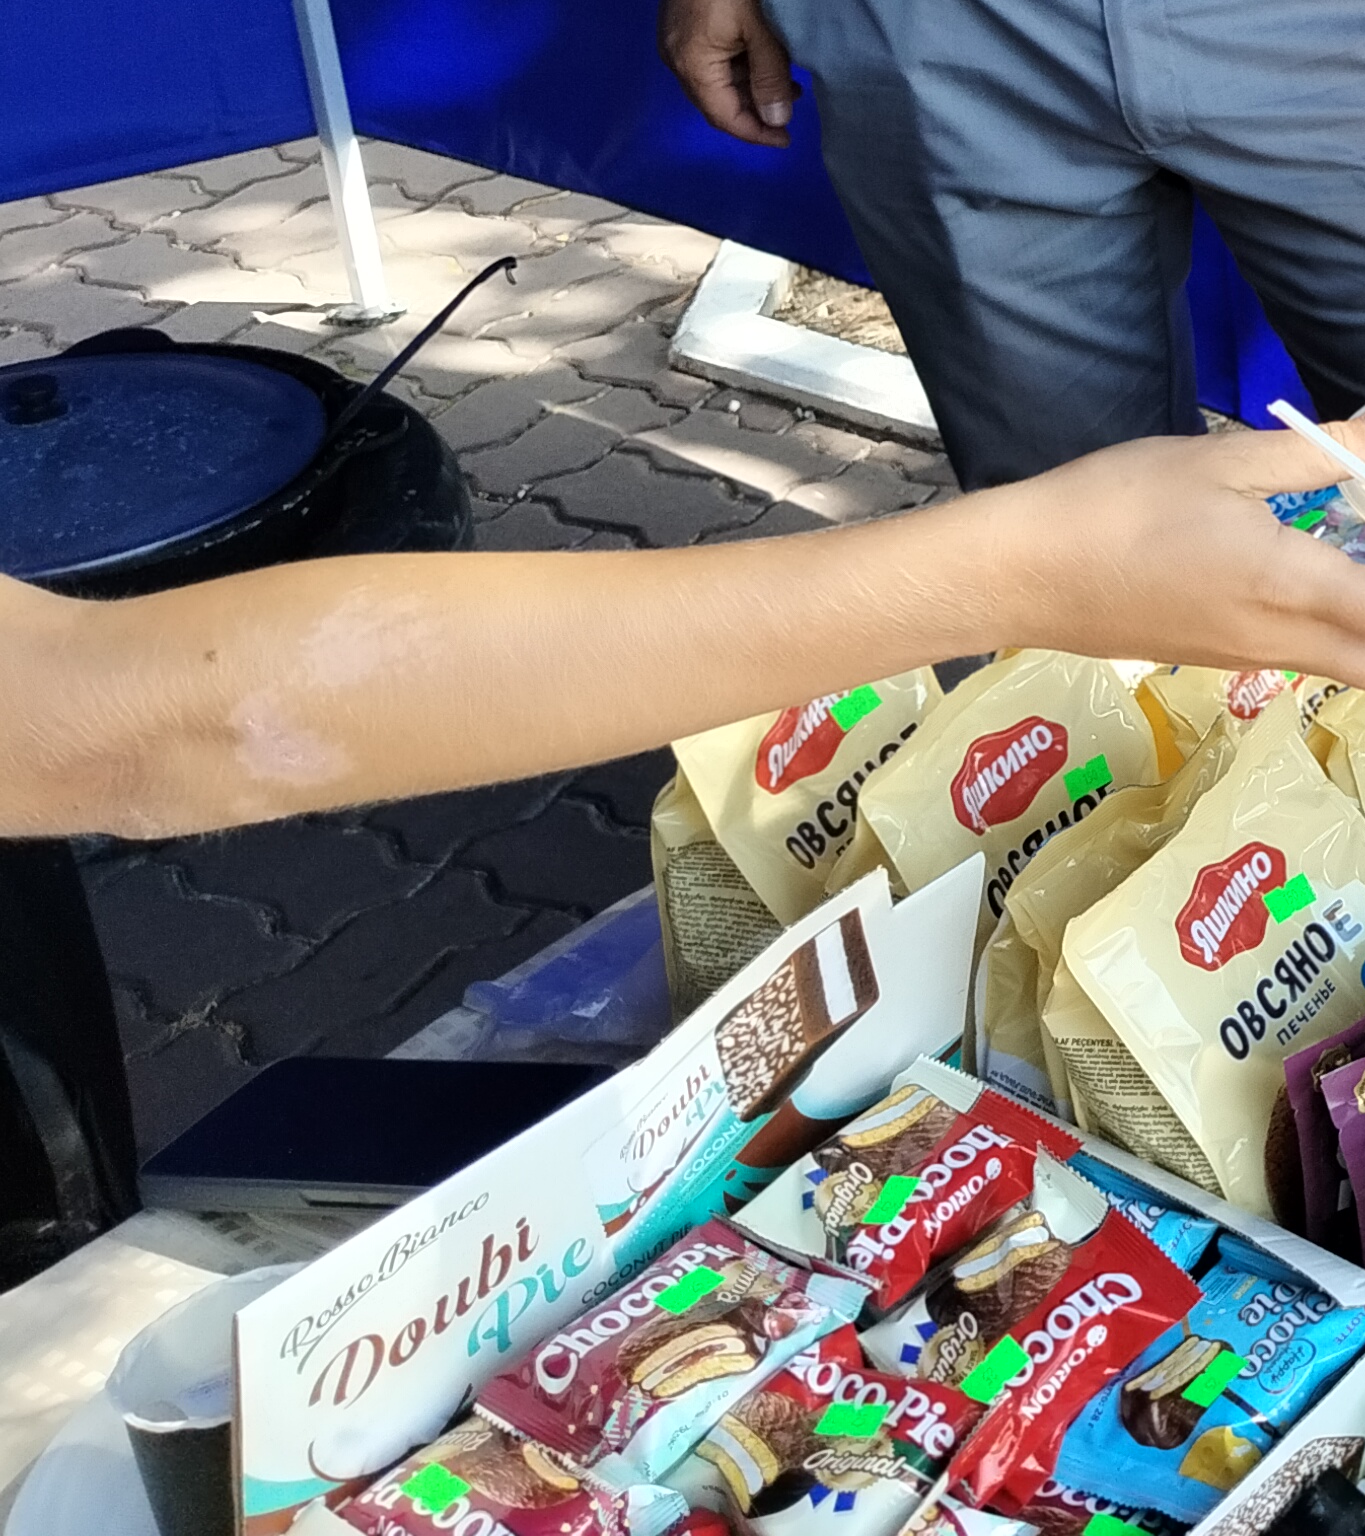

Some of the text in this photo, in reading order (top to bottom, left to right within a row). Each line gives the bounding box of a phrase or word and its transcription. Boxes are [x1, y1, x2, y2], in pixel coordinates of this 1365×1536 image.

[1190, 851, 1273, 964] ЯШКИНО
[1219, 898, 1363, 1061] ОВСЯНОЕ
[1276, 977, 1337, 1047] ПЕЧЕНЬЕ
[686, 1080, 726, 1128] Pi
[280, 1191, 490, 1361] Rosso Bianco
[308, 1216, 540, 1410] Doubi
[467, 1237, 596, 1358] Pie
[582, 1242, 664, 1306] COCONUT
[1020, 1347, 1088, 1422] ORION
[802, 1448, 907, 1479] Original
